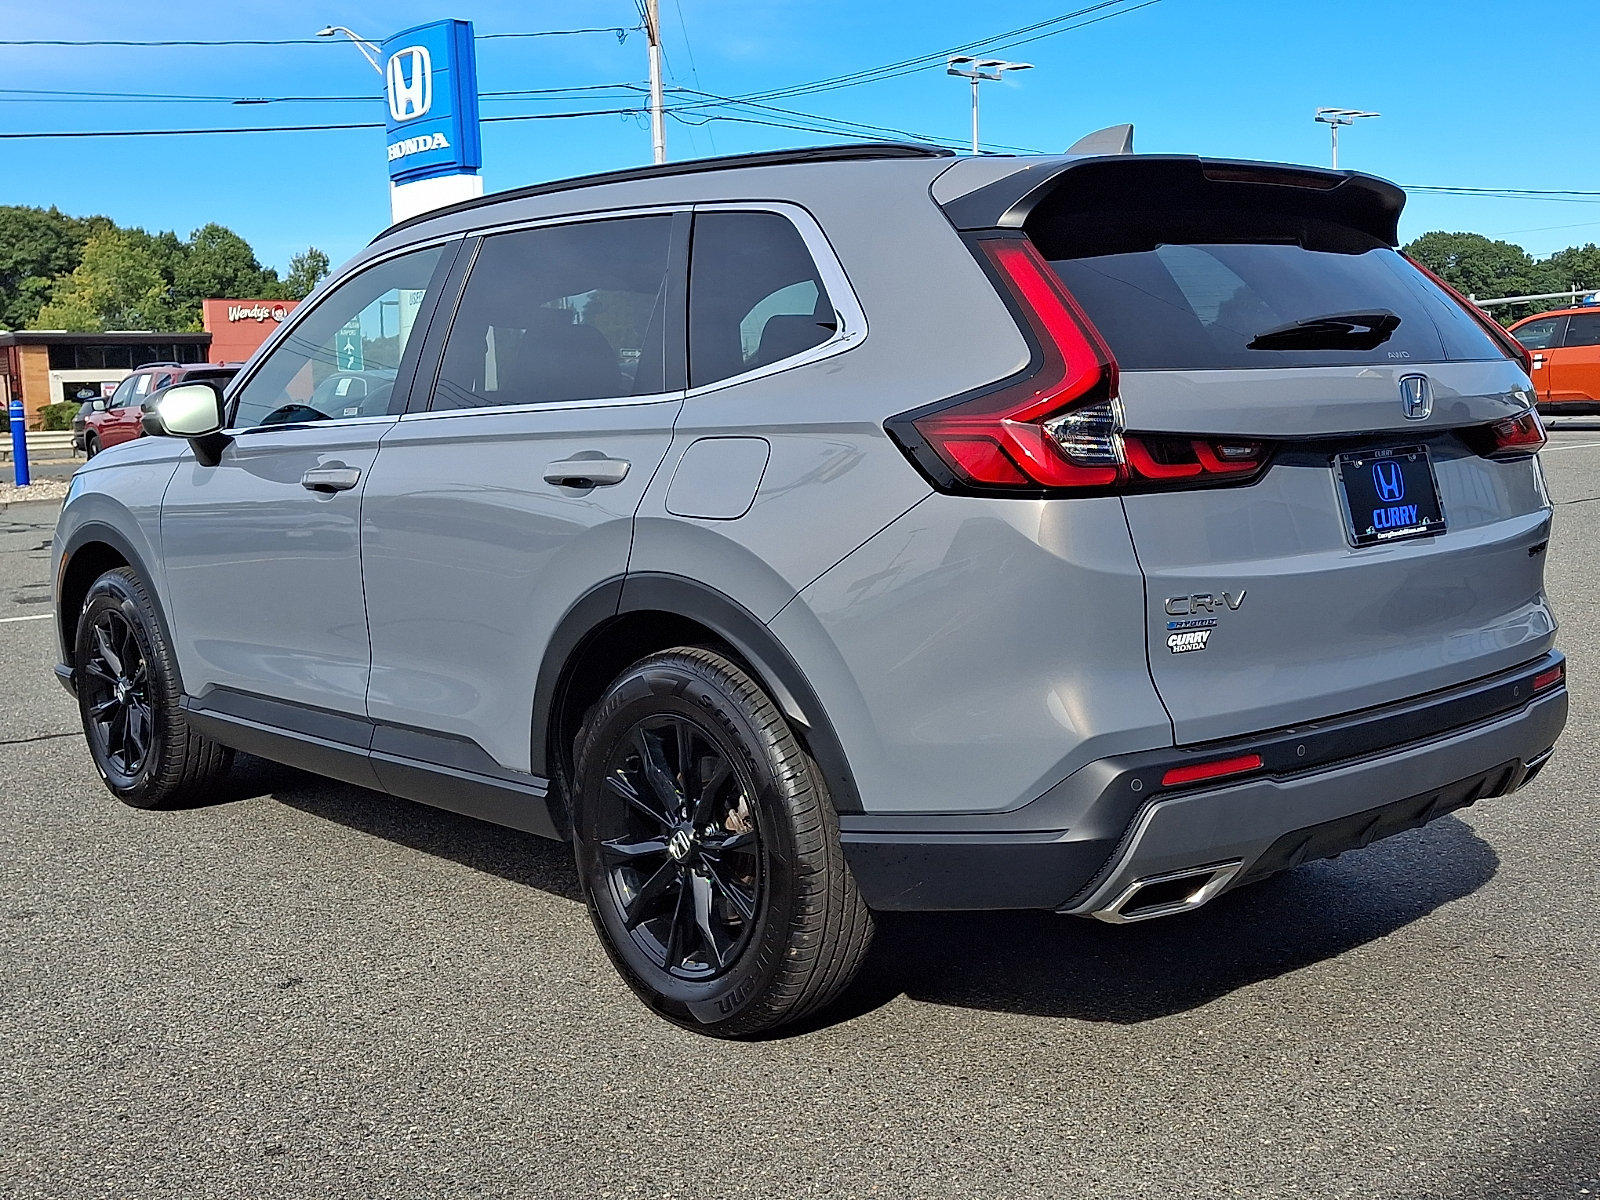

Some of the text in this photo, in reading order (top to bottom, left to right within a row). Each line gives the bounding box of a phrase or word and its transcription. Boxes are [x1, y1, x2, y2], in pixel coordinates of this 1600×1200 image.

[387, 133, 450, 161] HONDA
[229, 304, 269, 321] Wendy's
[1387, 351, 1410, 359] AWD
[1374, 449, 1393, 458] CURRY
[1373, 504, 1418, 529] CURRY
[1165, 590, 1247, 616] CR-V
[1167, 630, 1211, 647] CURRY
[1172, 642, 1205, 653] HONDA
